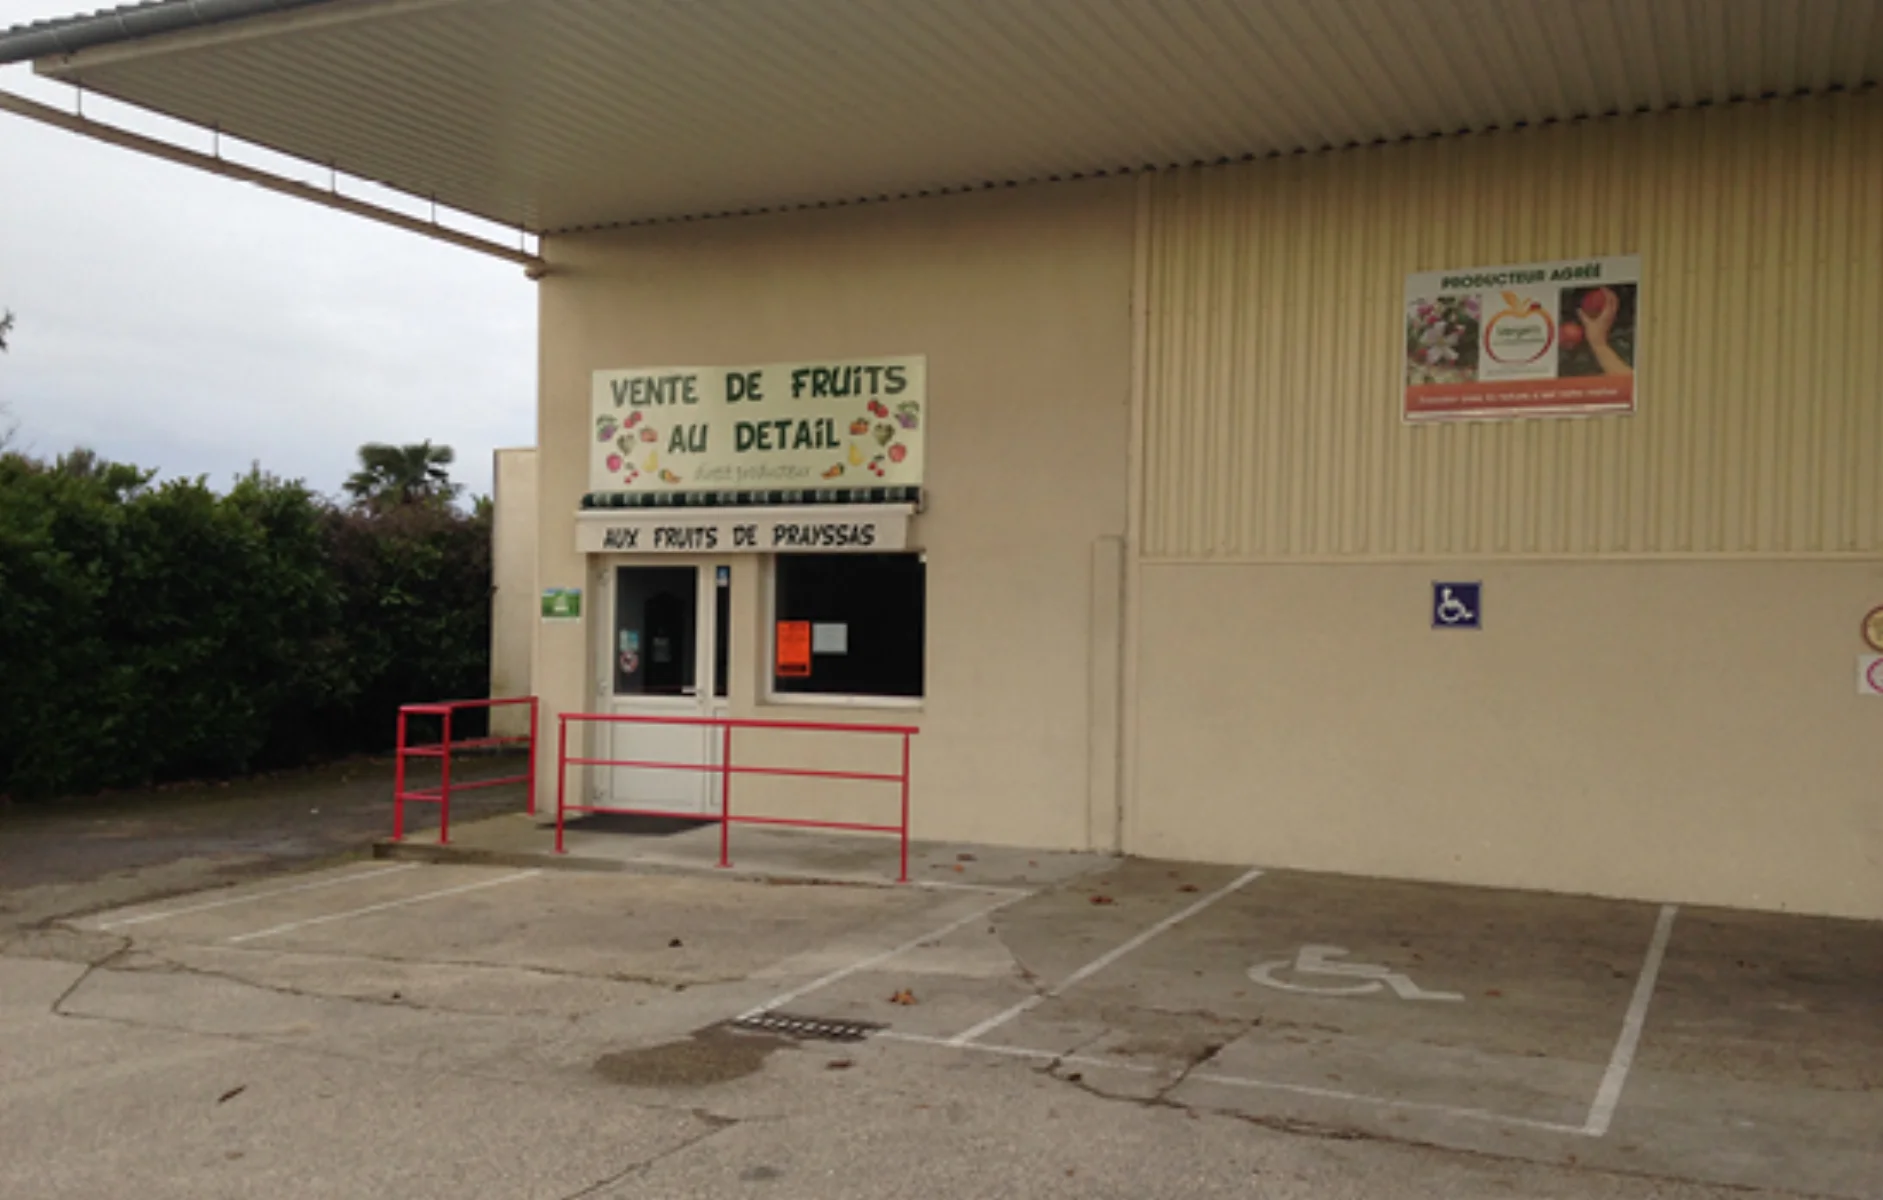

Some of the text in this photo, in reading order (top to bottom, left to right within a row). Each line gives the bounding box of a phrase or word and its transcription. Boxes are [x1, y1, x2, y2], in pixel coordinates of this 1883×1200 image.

[1441, 269, 1545, 289] PRODUCTEUR
[610, 375, 698, 406] VENTE
[725, 371, 763, 402] DE
[668, 424, 708, 453] AU
[603, 524, 875, 549] AUX FRUITS DE PRAYSSAS
